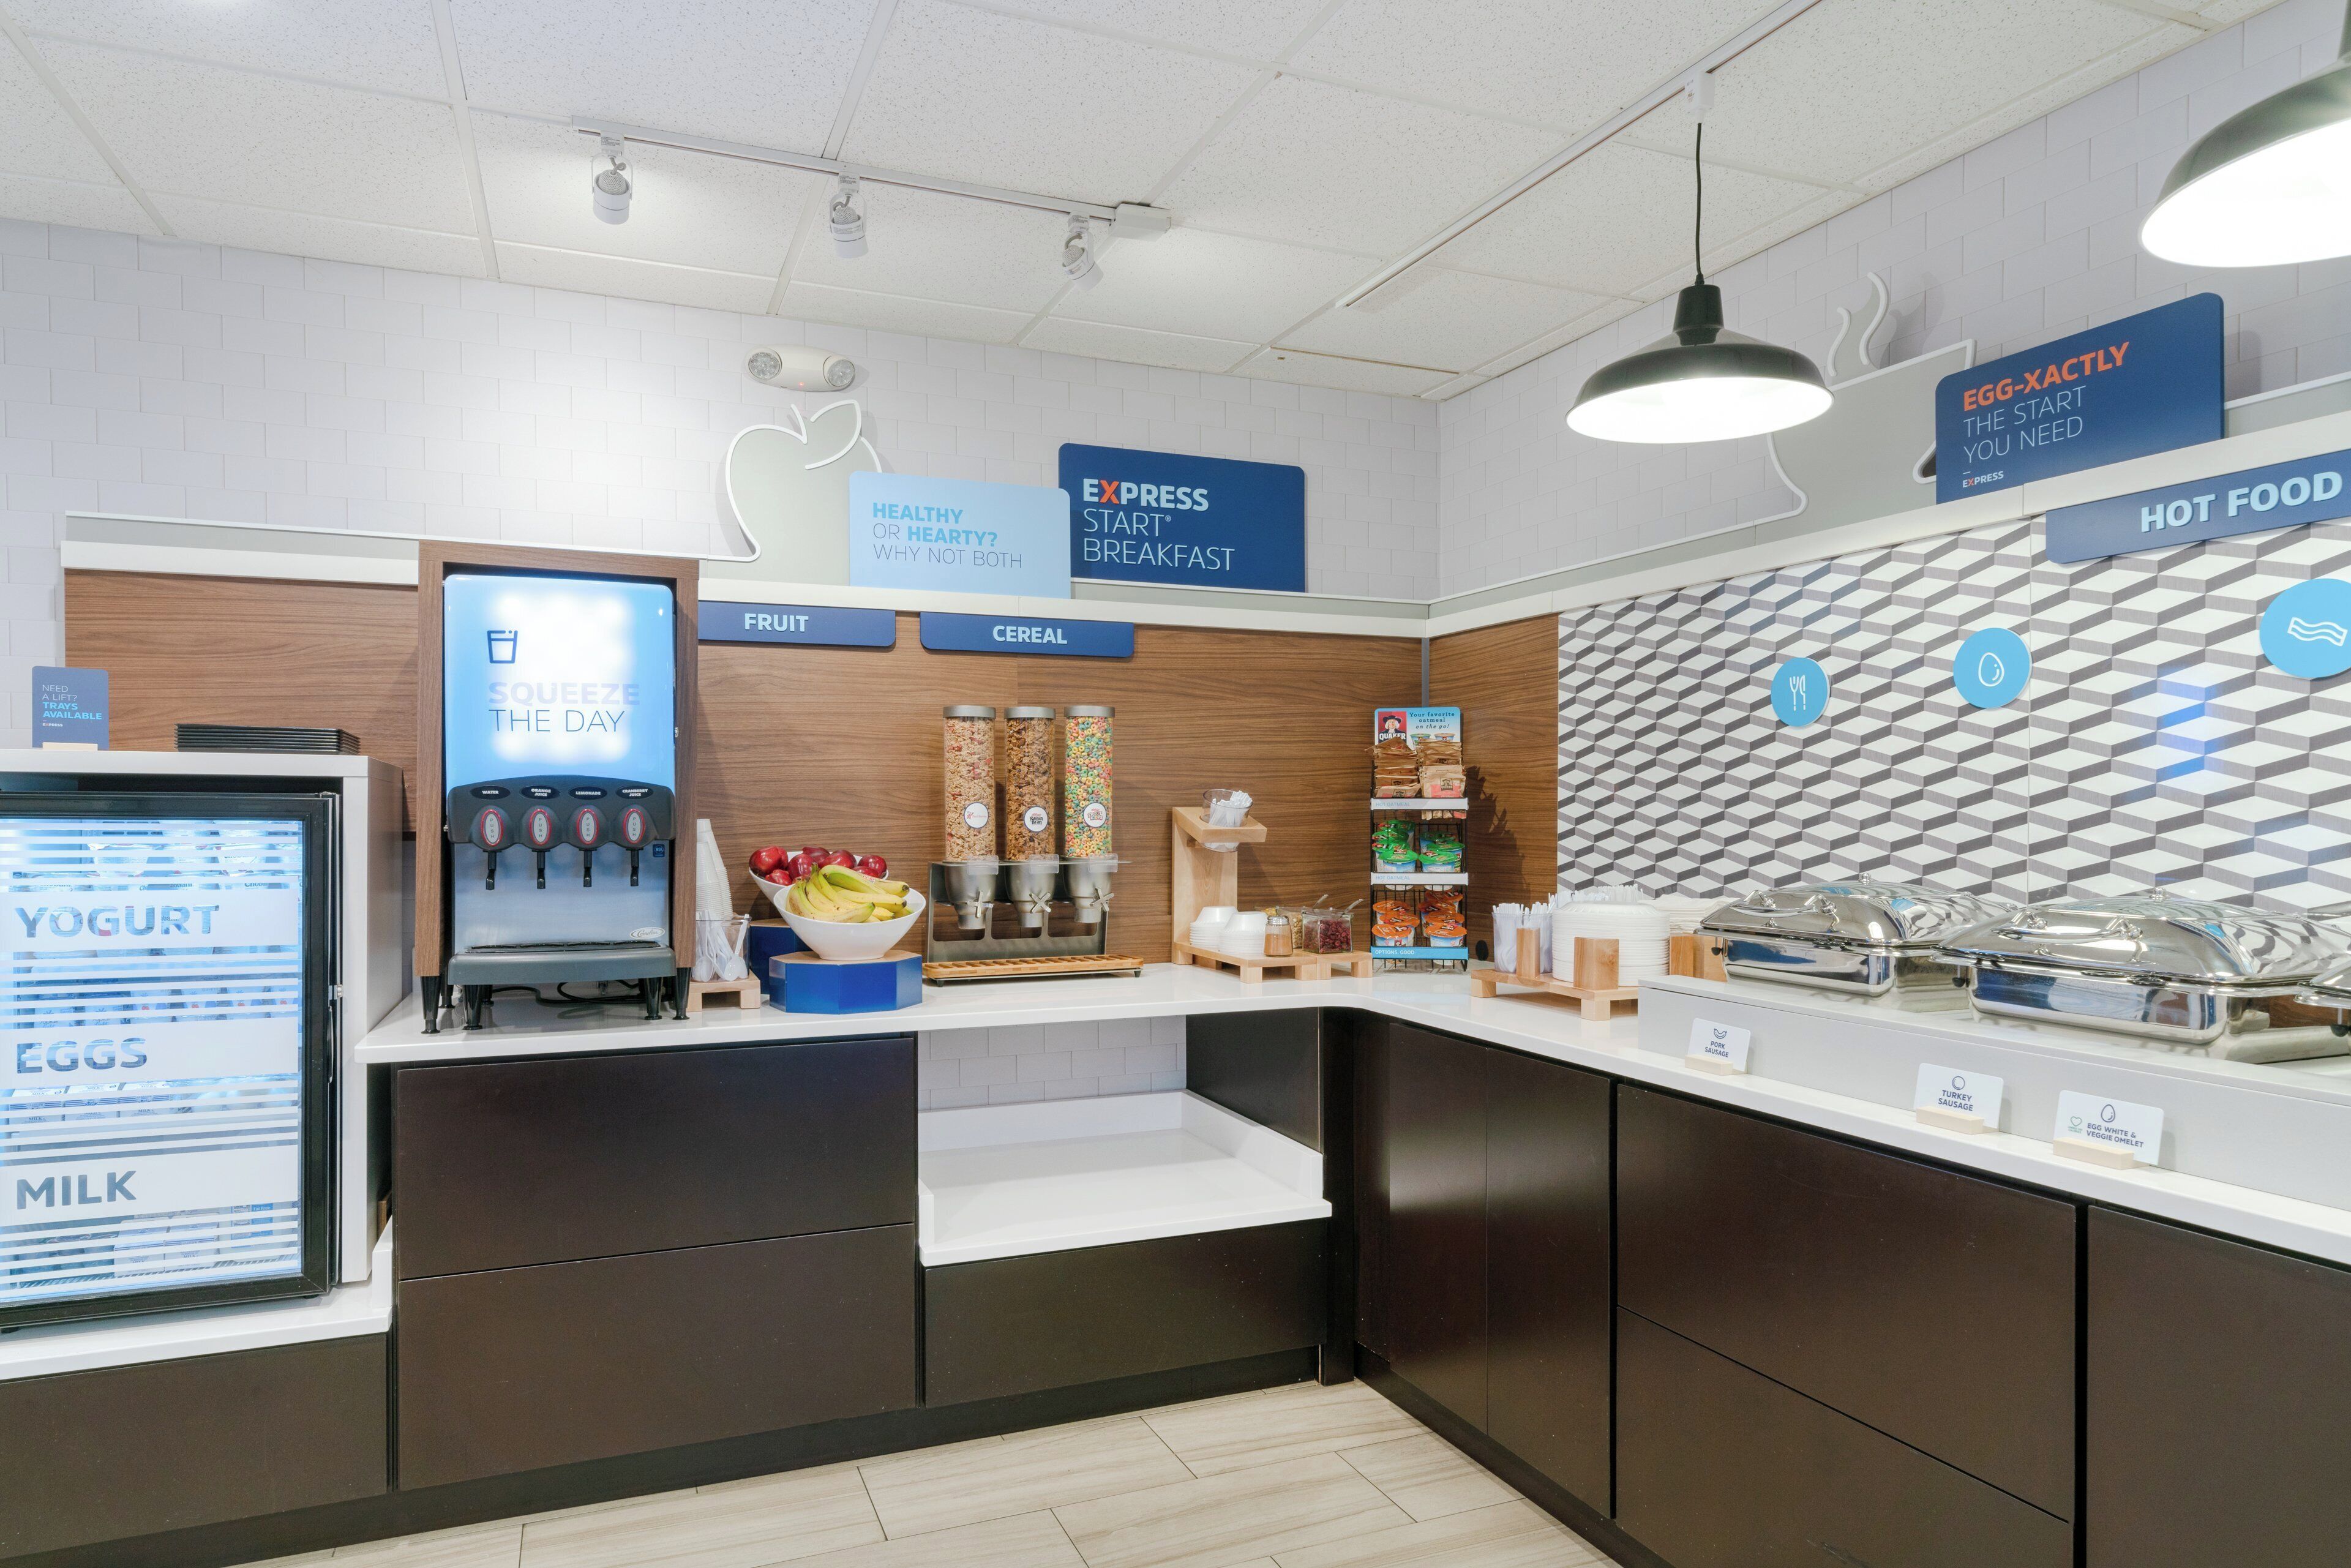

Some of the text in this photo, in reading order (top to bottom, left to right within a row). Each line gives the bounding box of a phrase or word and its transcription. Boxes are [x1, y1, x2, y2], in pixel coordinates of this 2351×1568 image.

[1963, 341, 2130, 412] EGG-XACTLY
[1963, 385, 2087, 438] THE START
[1963, 416, 2083, 464] YOU NEED
[1962, 470, 2004, 489] EXPRESS
[1083, 478, 1209, 512] EXPRESS
[2141, 471, 2343, 533] HOT FOOD
[872, 502, 963, 524] HEALTHY
[873, 523, 998, 547] OR HEARTY?
[873, 544, 1022, 569] WHY NOT BOTH
[1084, 538, 1235, 571] BREAKFAST
[744, 613, 809, 632] FRUIT
[992, 625, 1068, 645] CEREAL
[489, 681, 640, 707] SQUEEZE
[42, 702, 78, 710] TRAYS
[42, 711, 102, 720] AVAILABLE
[489, 709, 625, 732] THE DAY
[15, 905, 220, 938] YOGURT
[17, 1037, 148, 1074] EGGS
[1704, 1046, 1729, 1058] SAUSAGE
[1710, 1041, 1725, 1049] PORK
[1938, 1098, 1974, 1111] SAUSAGE
[1942, 1089, 1973, 1102] TURKEY
[2087, 1122, 2102, 1131] EGG
[2104, 1126, 2129, 1137] WHITE
[2087, 1130, 2112, 1141] VEGGIE
[2114, 1136, 2144, 1148] OMELET
[17, 1170, 137, 1210] MILK
